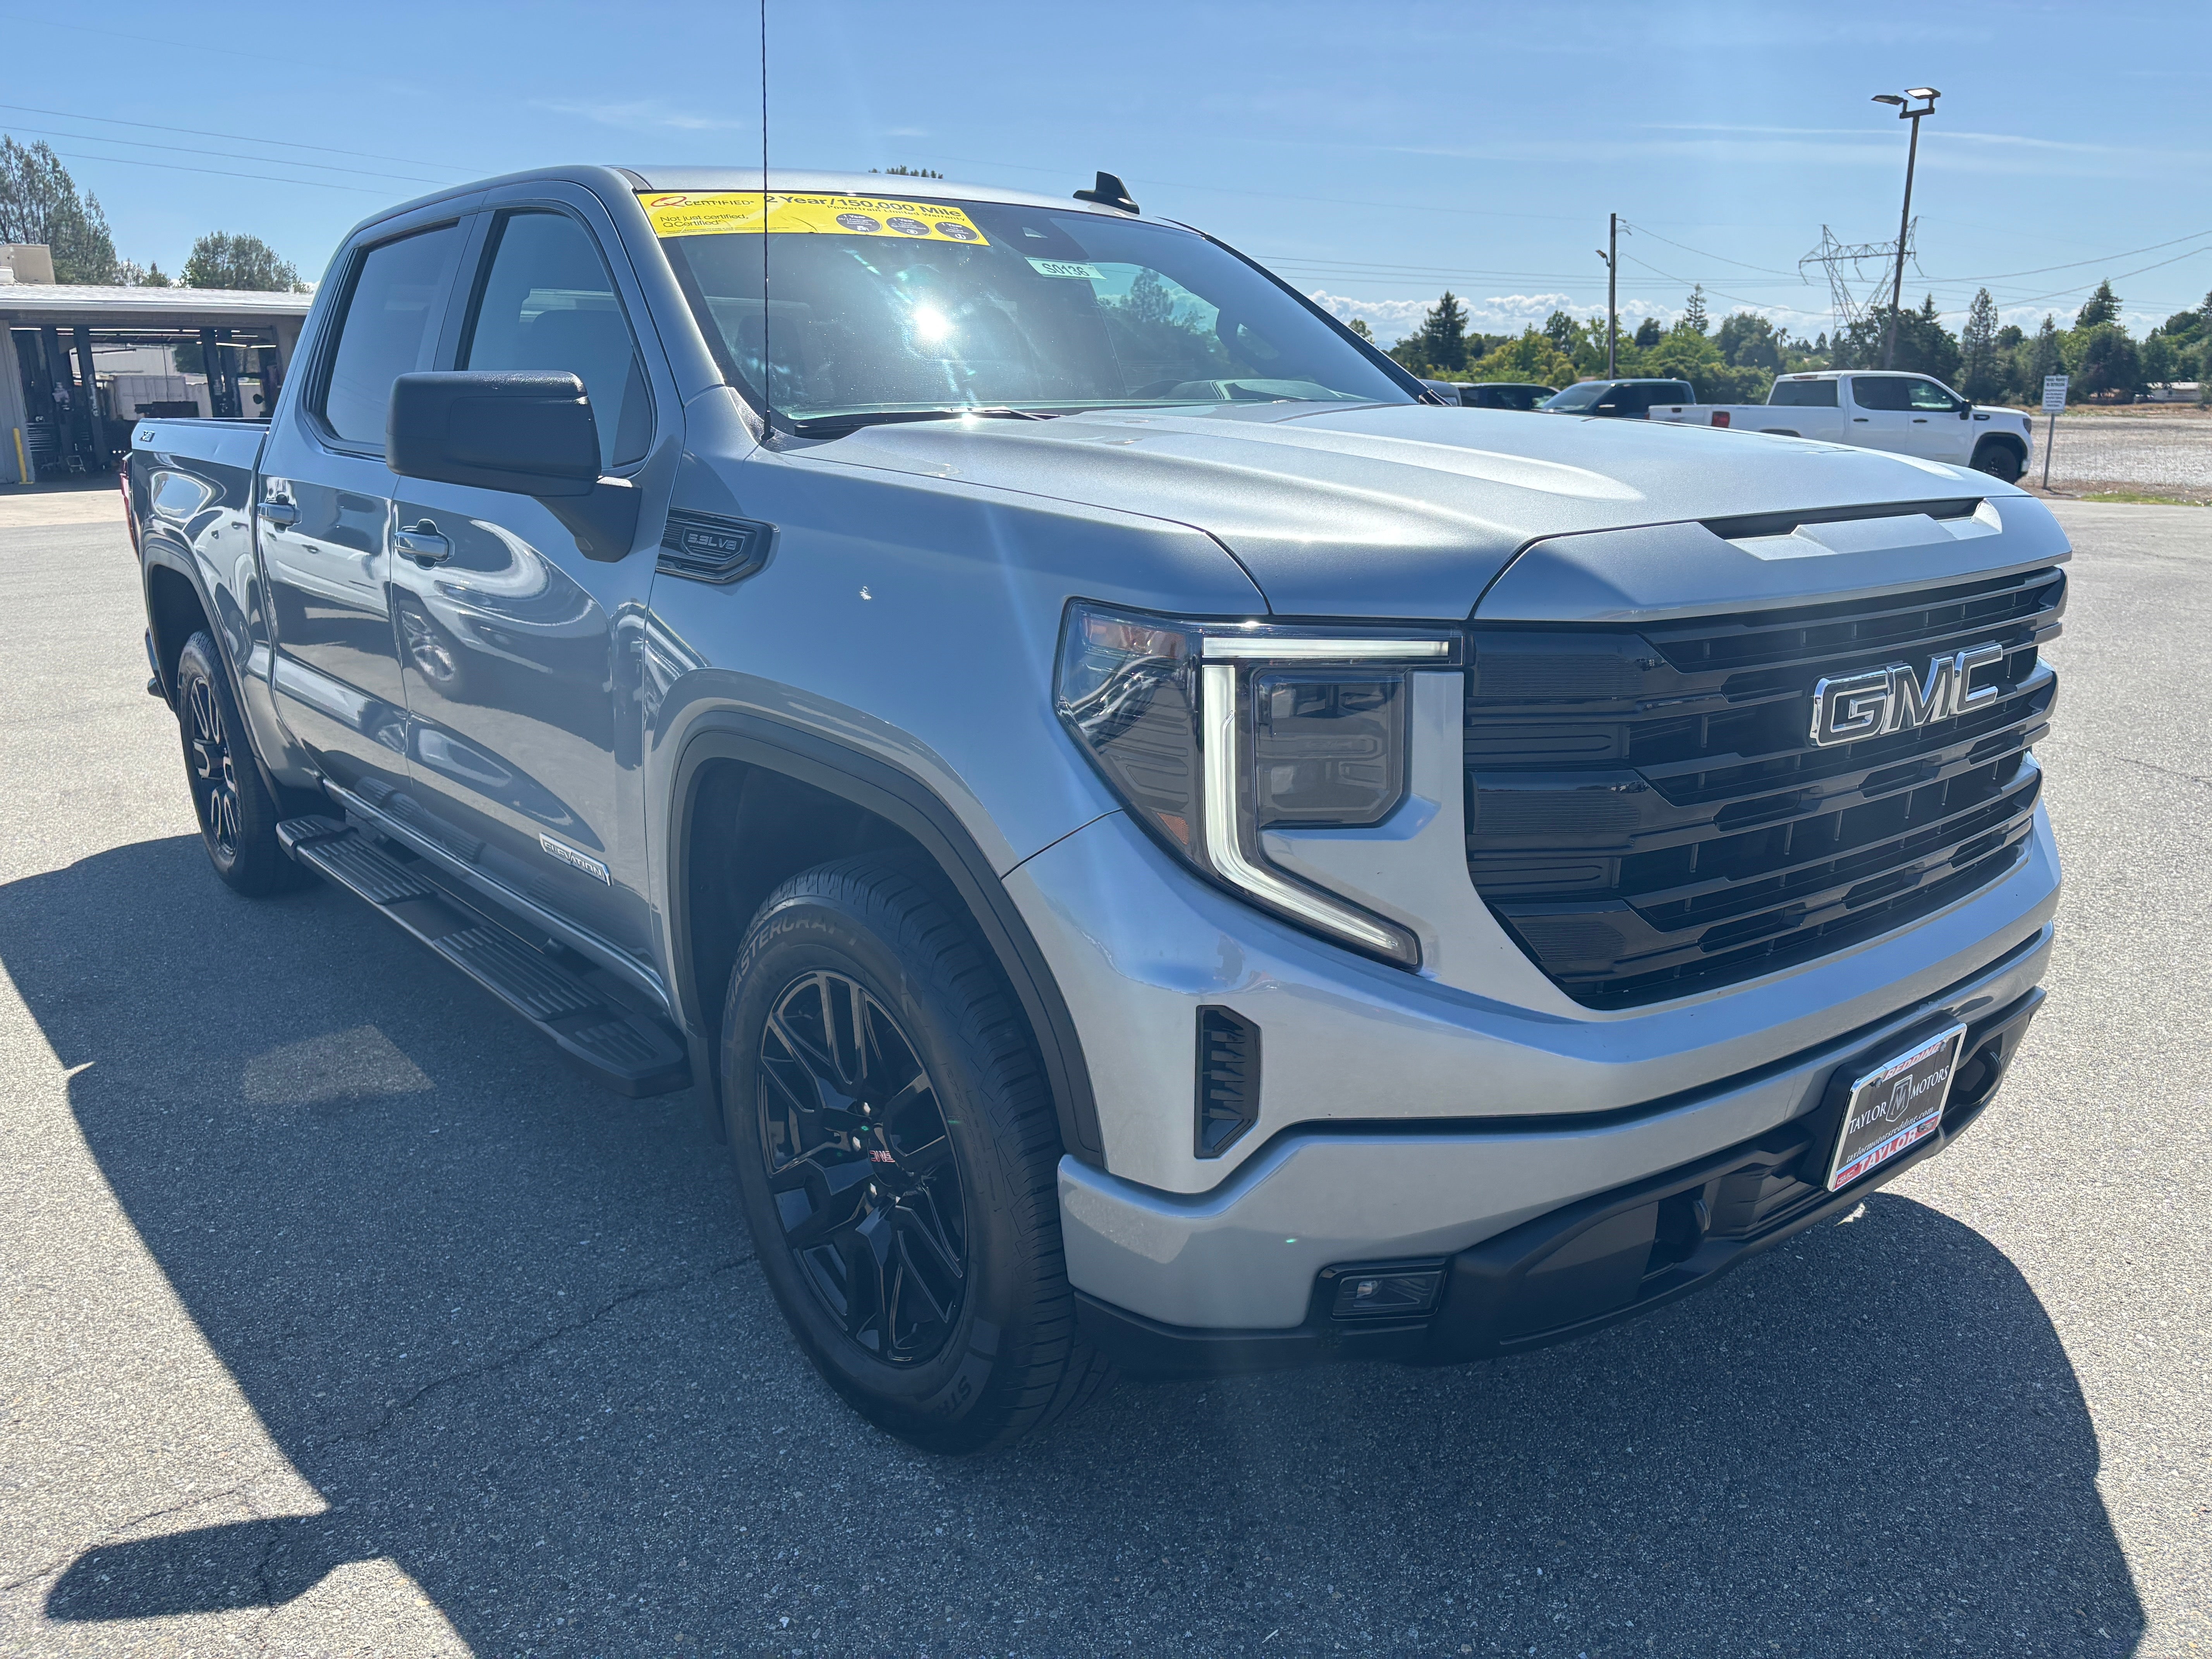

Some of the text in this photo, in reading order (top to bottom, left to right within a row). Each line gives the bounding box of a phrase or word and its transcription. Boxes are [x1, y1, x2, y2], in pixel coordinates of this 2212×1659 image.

[779, 196, 915, 211] Year/150,000
[919, 206, 962, 217] Mile
[922, 213, 965, 221] Warranty
[1042, 263, 1090, 276] S0136
[1810, 643, 2003, 747] GMC
[544, 842, 602, 877] ELEVATION
[1884, 1042, 1941, 1079] REDDING
[1849, 1102, 1887, 1134] TAYLOR
[1910, 1065, 1949, 1099] MOTORS
[1846, 1106, 1934, 1163] taylormotorsredding.com
[1859, 1127, 1918, 1173] TAYLOR
